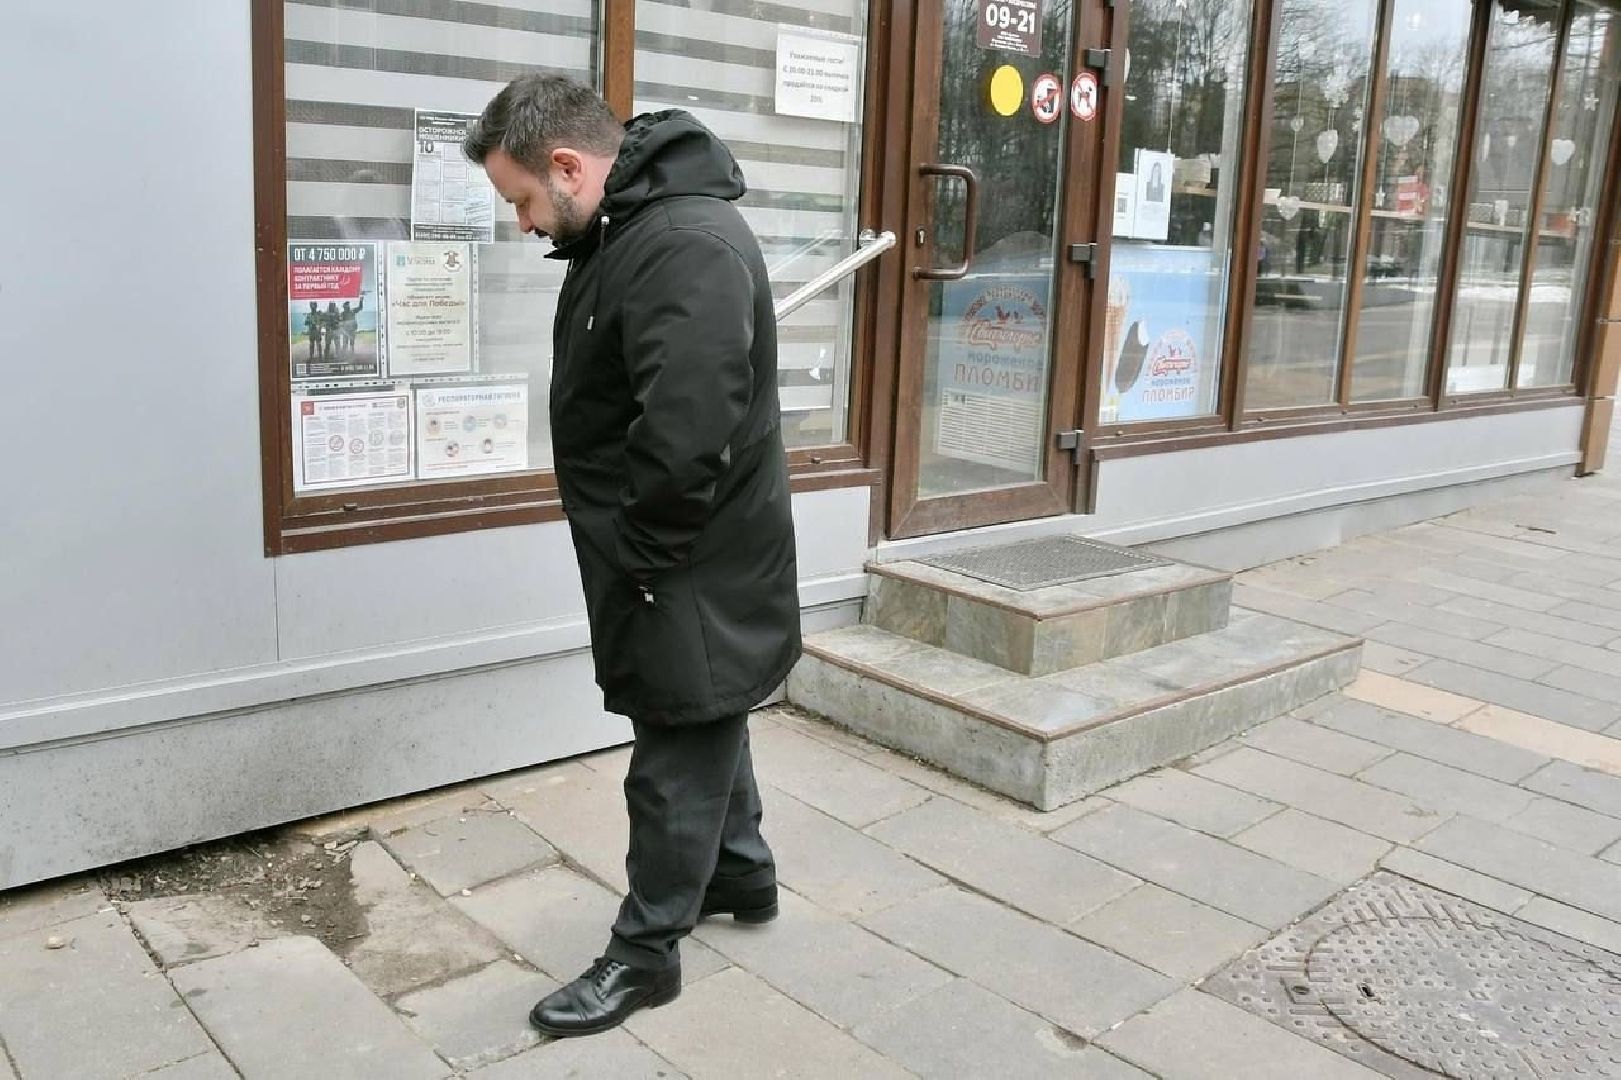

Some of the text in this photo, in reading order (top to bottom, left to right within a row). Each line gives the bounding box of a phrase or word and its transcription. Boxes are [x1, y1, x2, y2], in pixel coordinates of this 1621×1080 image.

[985, 3, 1036, 34] 09-21
[420, 141, 435, 154] 10
[294, 248, 307, 260] ОТ
[308, 248, 315, 260] 4
[317, 248, 335, 260] 750
[338, 248, 356, 260] 000
[954, 363, 1041, 392] ПЛОМБИ
